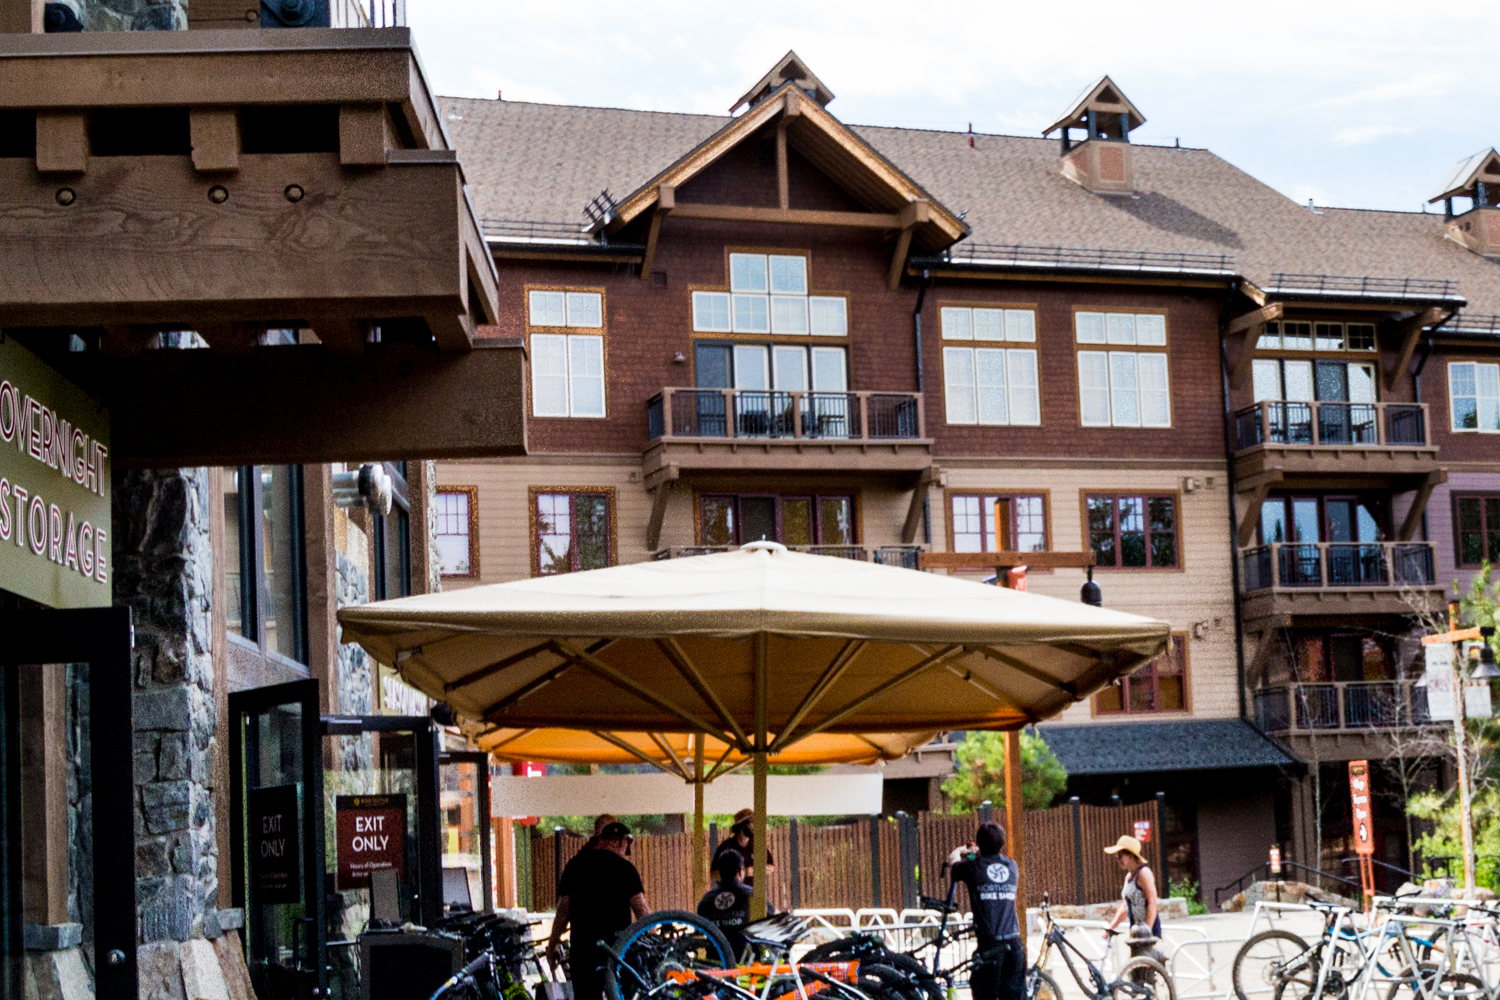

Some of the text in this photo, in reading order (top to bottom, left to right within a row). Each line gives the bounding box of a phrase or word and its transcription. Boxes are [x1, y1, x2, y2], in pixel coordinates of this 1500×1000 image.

[0, 380, 108, 497] OVERNIGHT
[0, 477, 108, 584] STORAGE
[262, 814, 282, 834] EXIT
[355, 816, 385, 832] EXIT
[260, 838, 286, 858] ONLY
[352, 835, 389, 852] ONLY
[980, 891, 997, 900] BIKE
